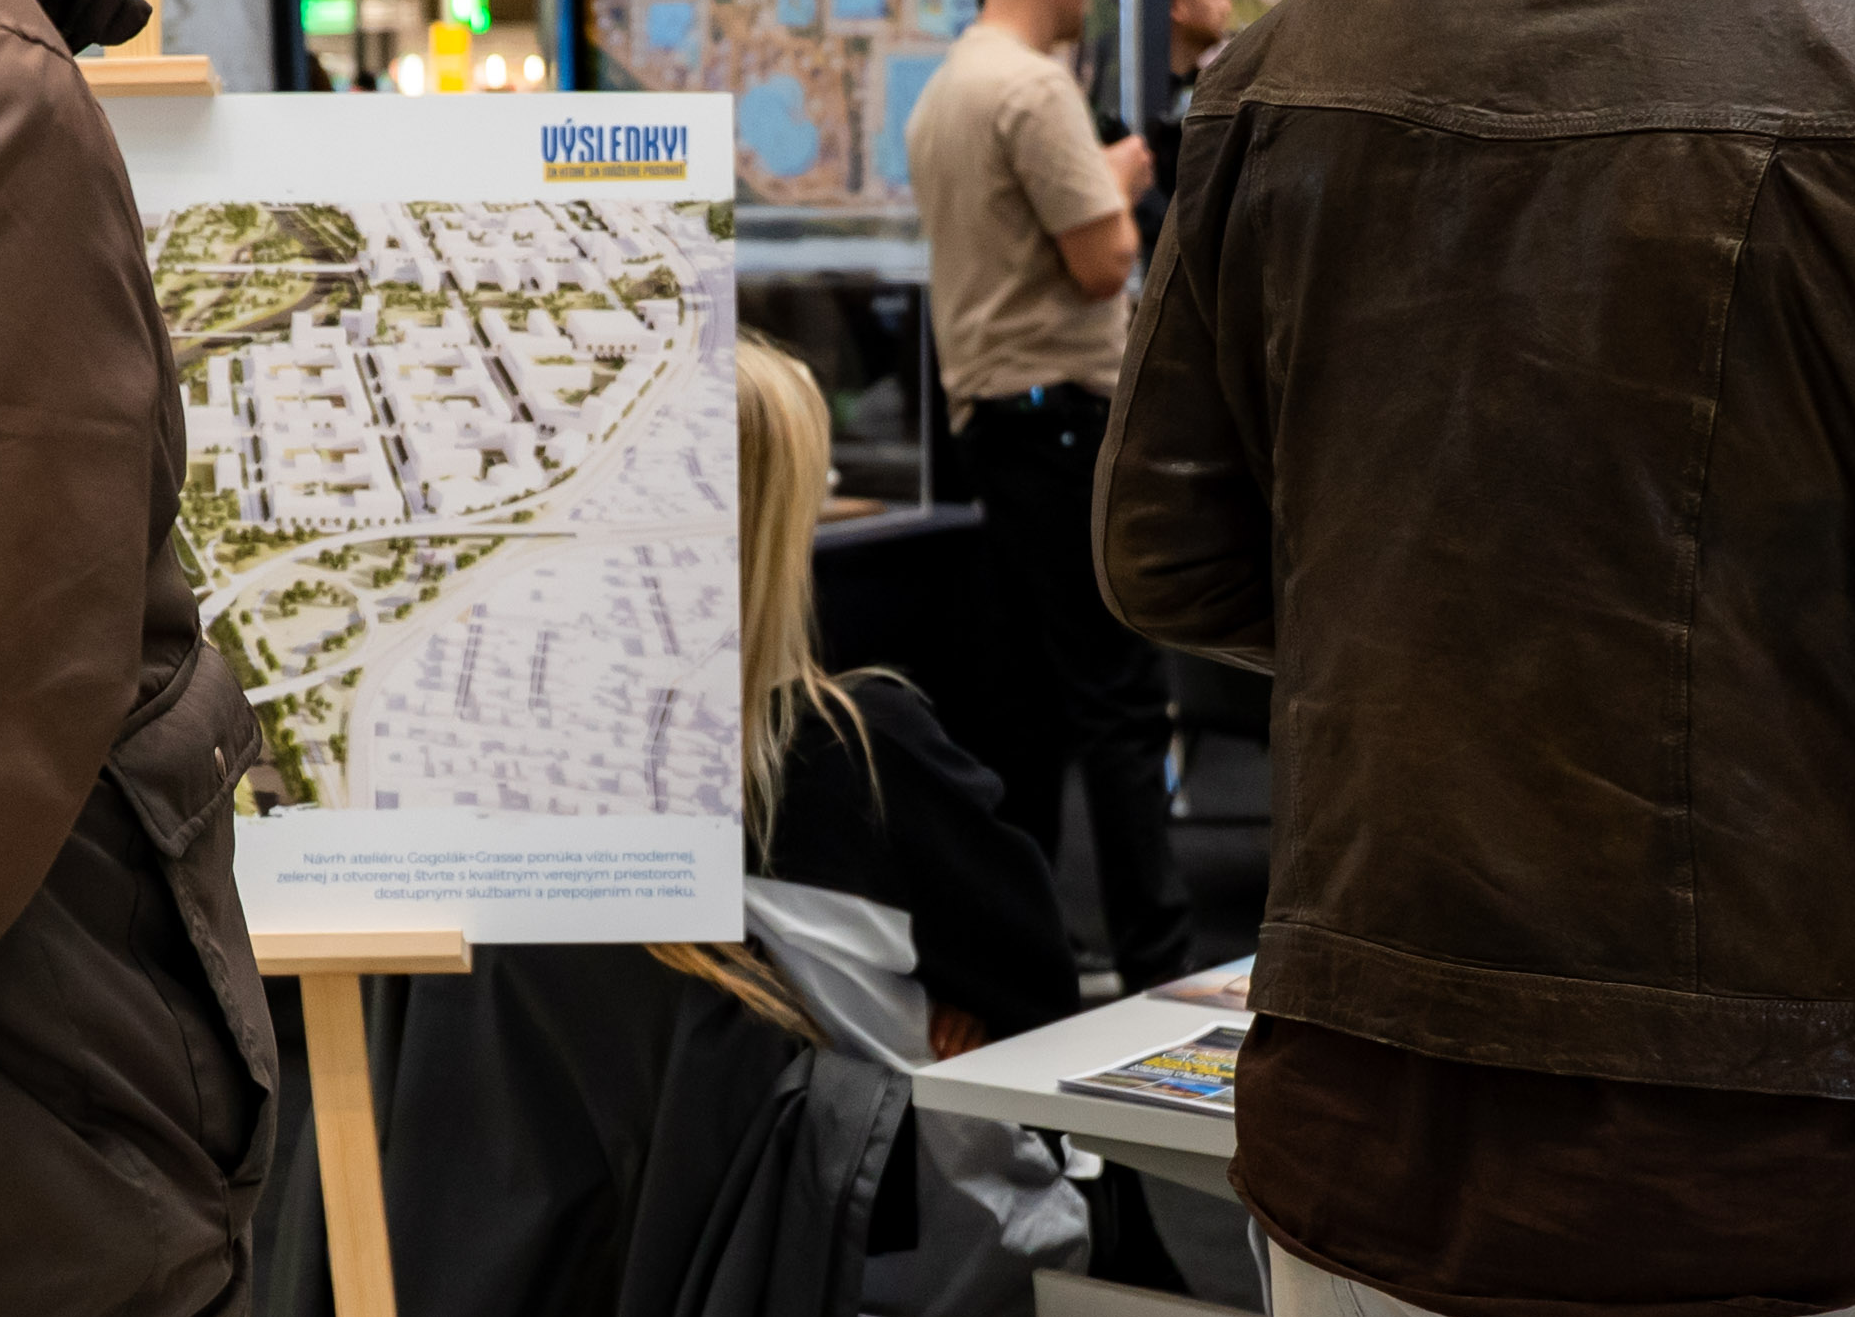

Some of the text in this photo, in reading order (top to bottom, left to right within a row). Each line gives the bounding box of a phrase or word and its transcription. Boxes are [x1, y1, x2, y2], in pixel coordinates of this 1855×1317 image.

[541, 117, 687, 163] VÝSLEDKY!
[303, 852, 346, 865] Návrh
[527, 851, 582, 865] ponúka
[277, 871, 327, 885] zelenej
[331, 872, 339, 883] a
[345, 870, 410, 884] otvorenej
[413, 868, 455, 882] štvrte
[544, 867, 610, 882] verejným
[465, 885, 531, 900] službami
[535, 887, 543, 898] a
[635, 887, 654, 898] na
[657, 885, 696, 898] rieku.
